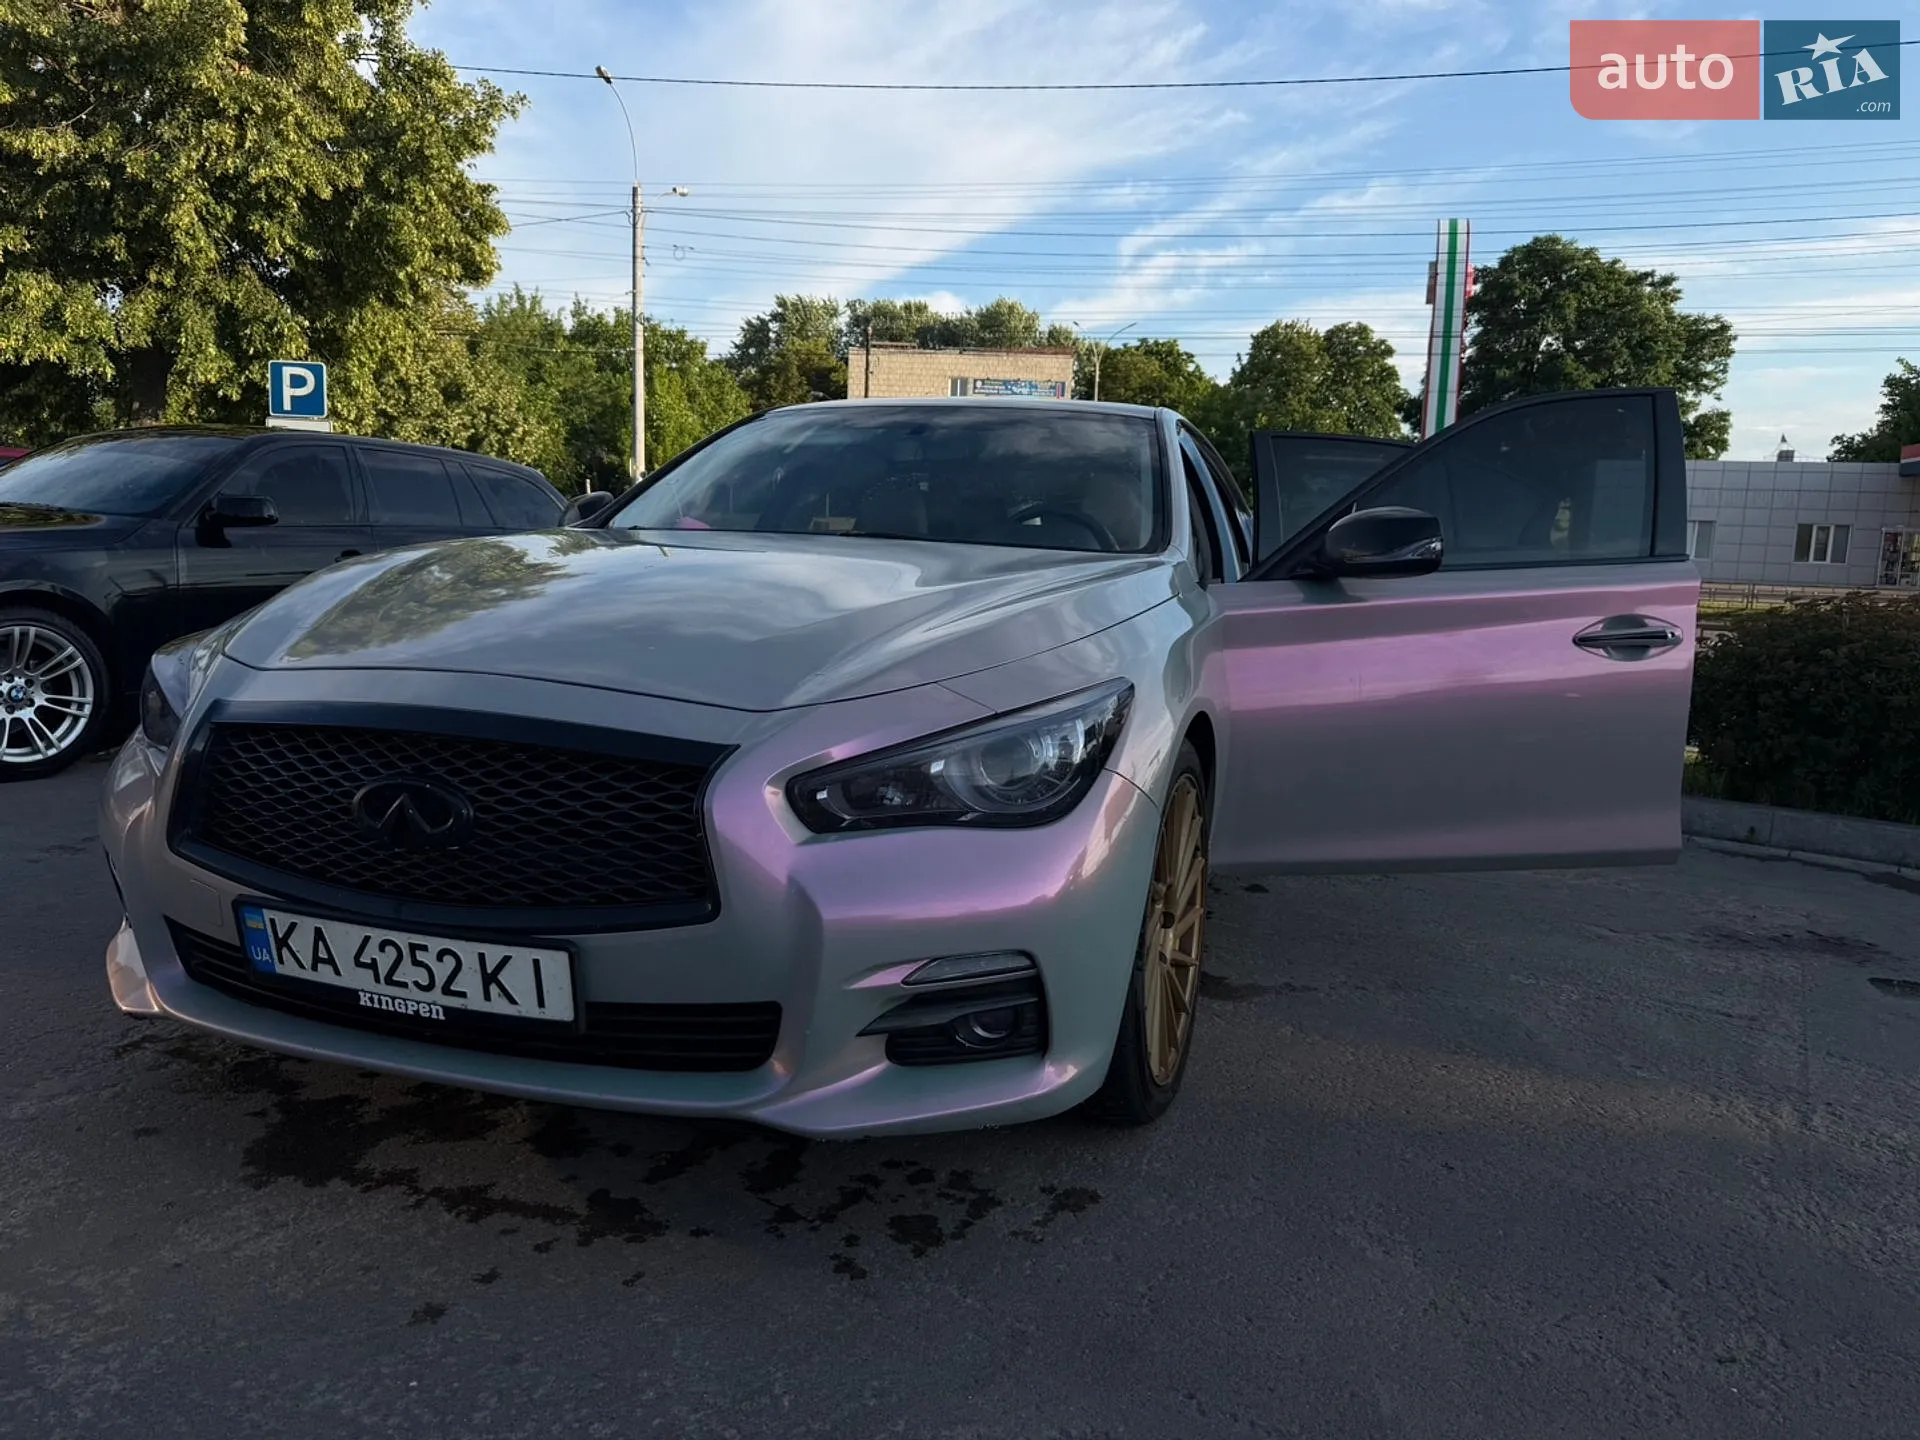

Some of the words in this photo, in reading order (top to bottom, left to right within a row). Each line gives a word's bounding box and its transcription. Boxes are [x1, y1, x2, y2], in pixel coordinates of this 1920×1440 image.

[282, 366, 315, 411] P
[251, 945, 272, 963] UA
[269, 917, 343, 977] KA
[353, 934, 468, 999] 4252
[477, 951, 546, 1010] KI
